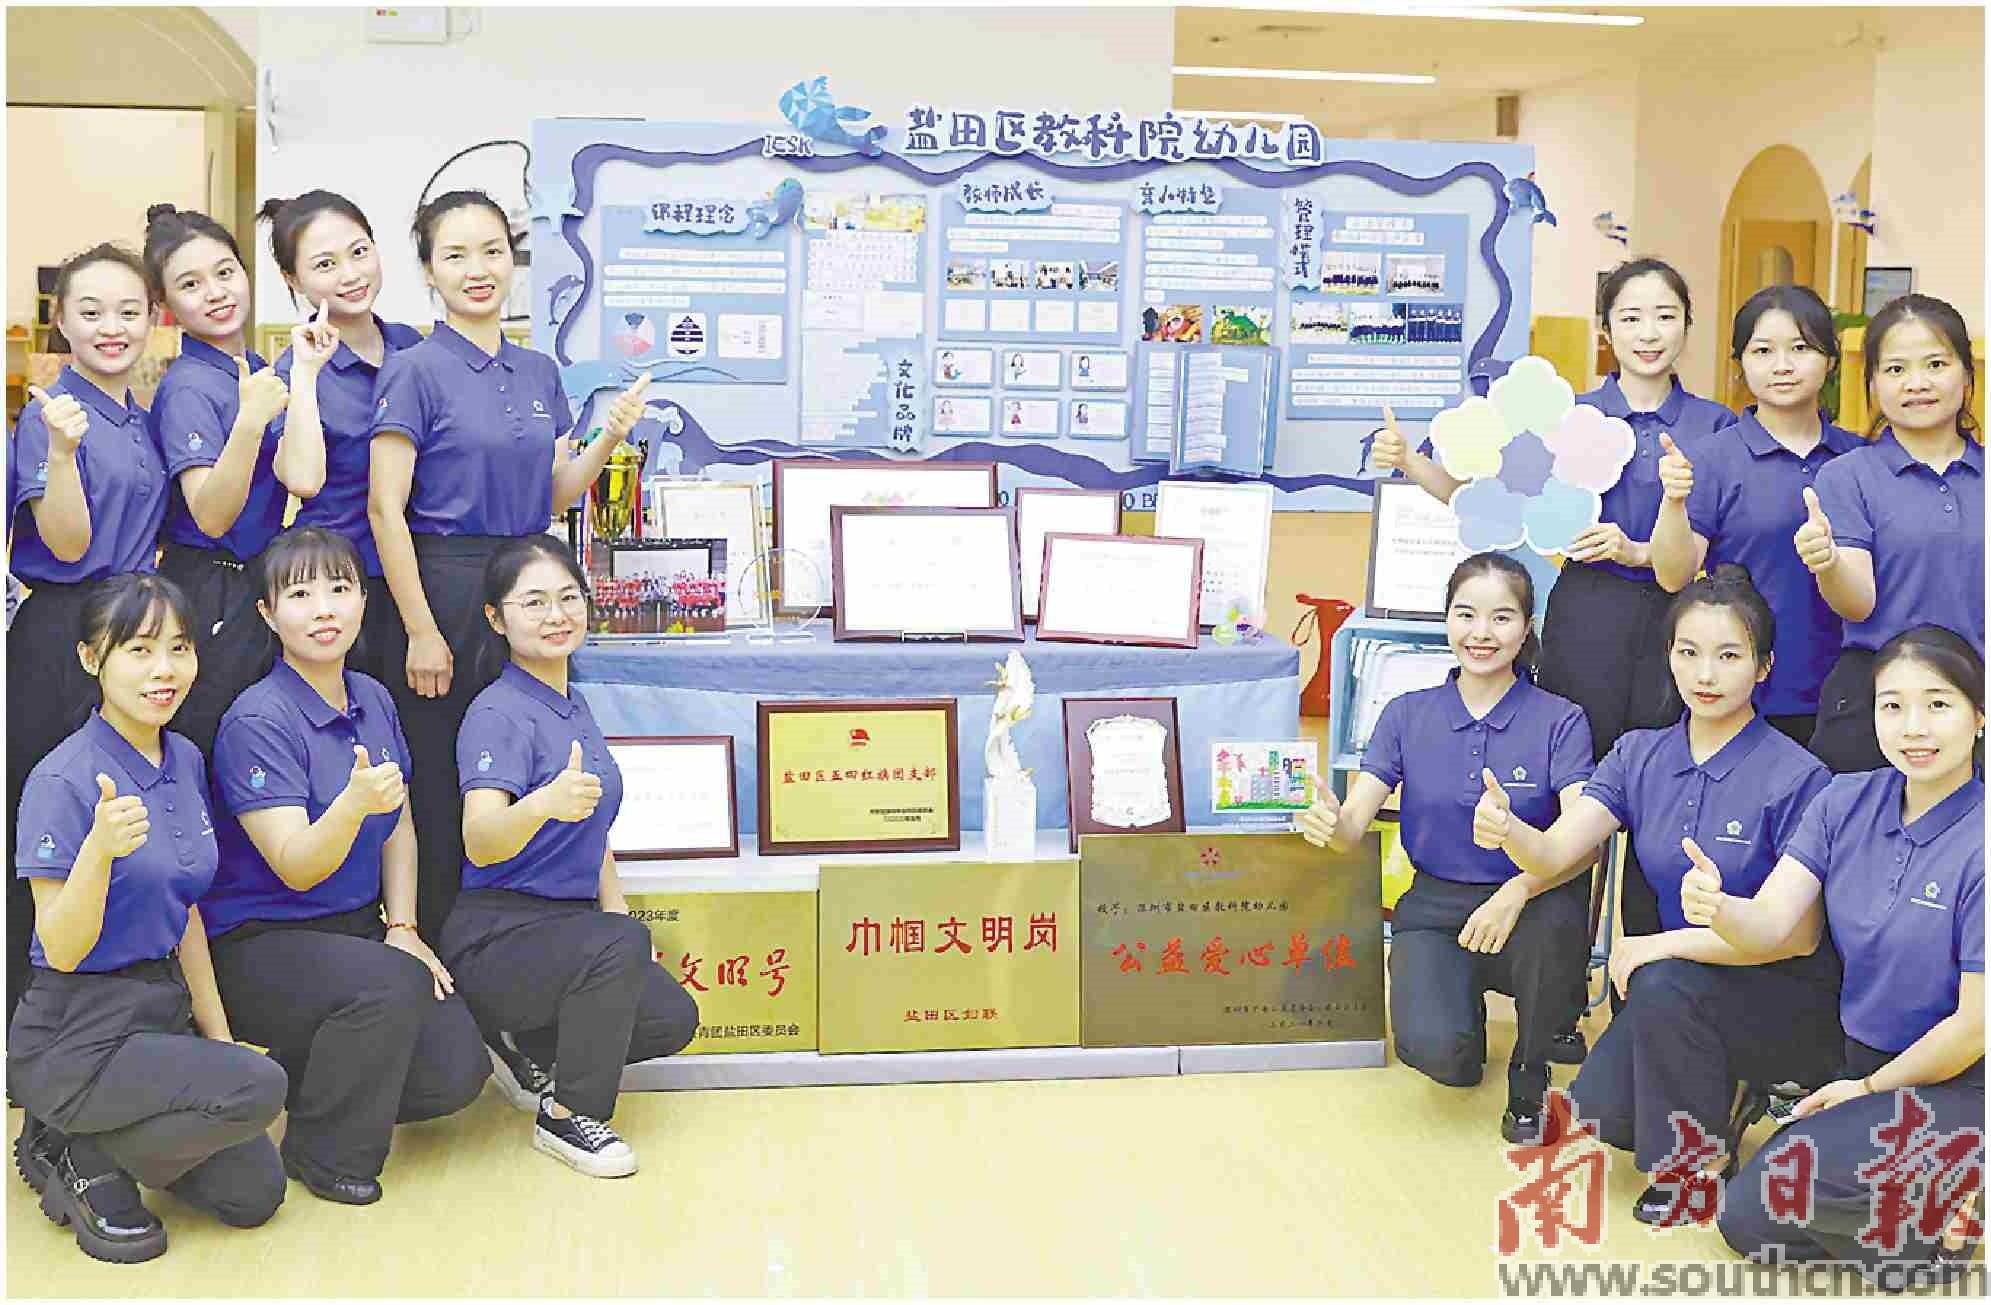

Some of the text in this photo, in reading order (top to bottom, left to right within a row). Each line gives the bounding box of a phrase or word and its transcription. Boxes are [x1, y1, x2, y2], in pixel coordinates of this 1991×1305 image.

[906, 106, 1321, 160] 盐田区教科院幼儿园
[652, 203, 735, 224] 课程理念
[963, 180, 1044, 204] 教师成长
[1290, 197, 1314, 278] 管理模式
[894, 359, 915, 442] 文化品牌
[783, 766, 936, 784] 盐田区五四红旗团支部
[846, 912, 1058, 956] 巾帼文明岗
[1112, 931, 1356, 976] 公益爱心单位
[656, 948, 791, 998] 文明号
[904, 1008, 999, 1022] 盐田区妇联
